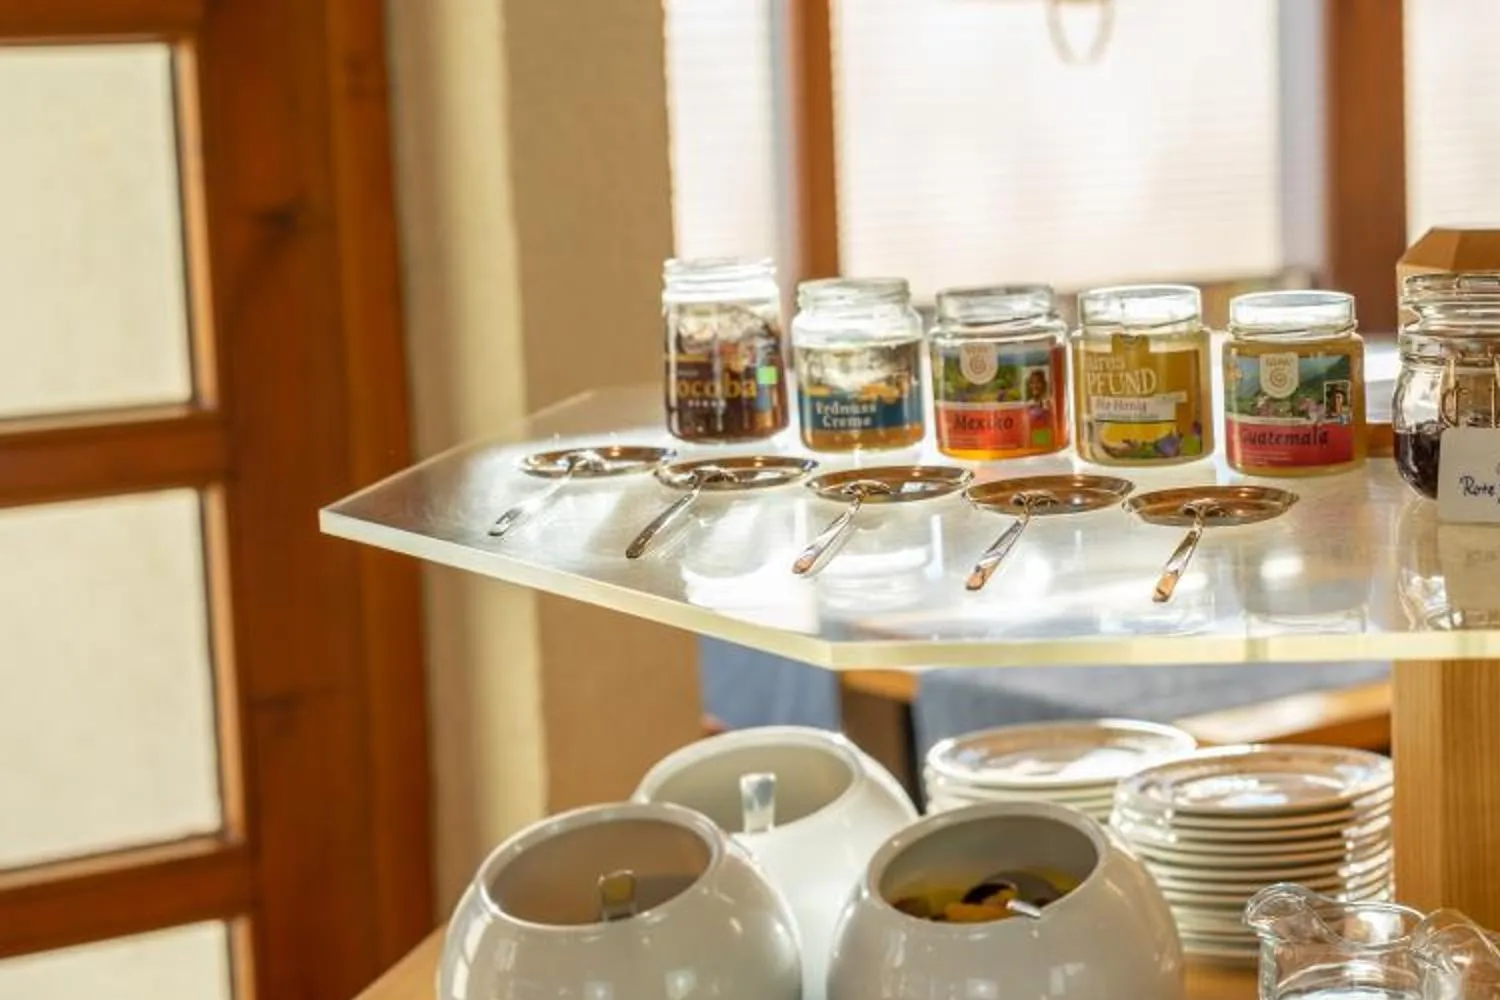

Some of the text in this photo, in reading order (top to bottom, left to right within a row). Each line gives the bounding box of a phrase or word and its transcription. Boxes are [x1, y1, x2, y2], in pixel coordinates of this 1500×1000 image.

[1086, 368, 1156, 396] PFUND
[822, 415, 872, 428] Creme
[954, 412, 1014, 431] Mexiko
[1241, 424, 1328, 447] Guatemala
